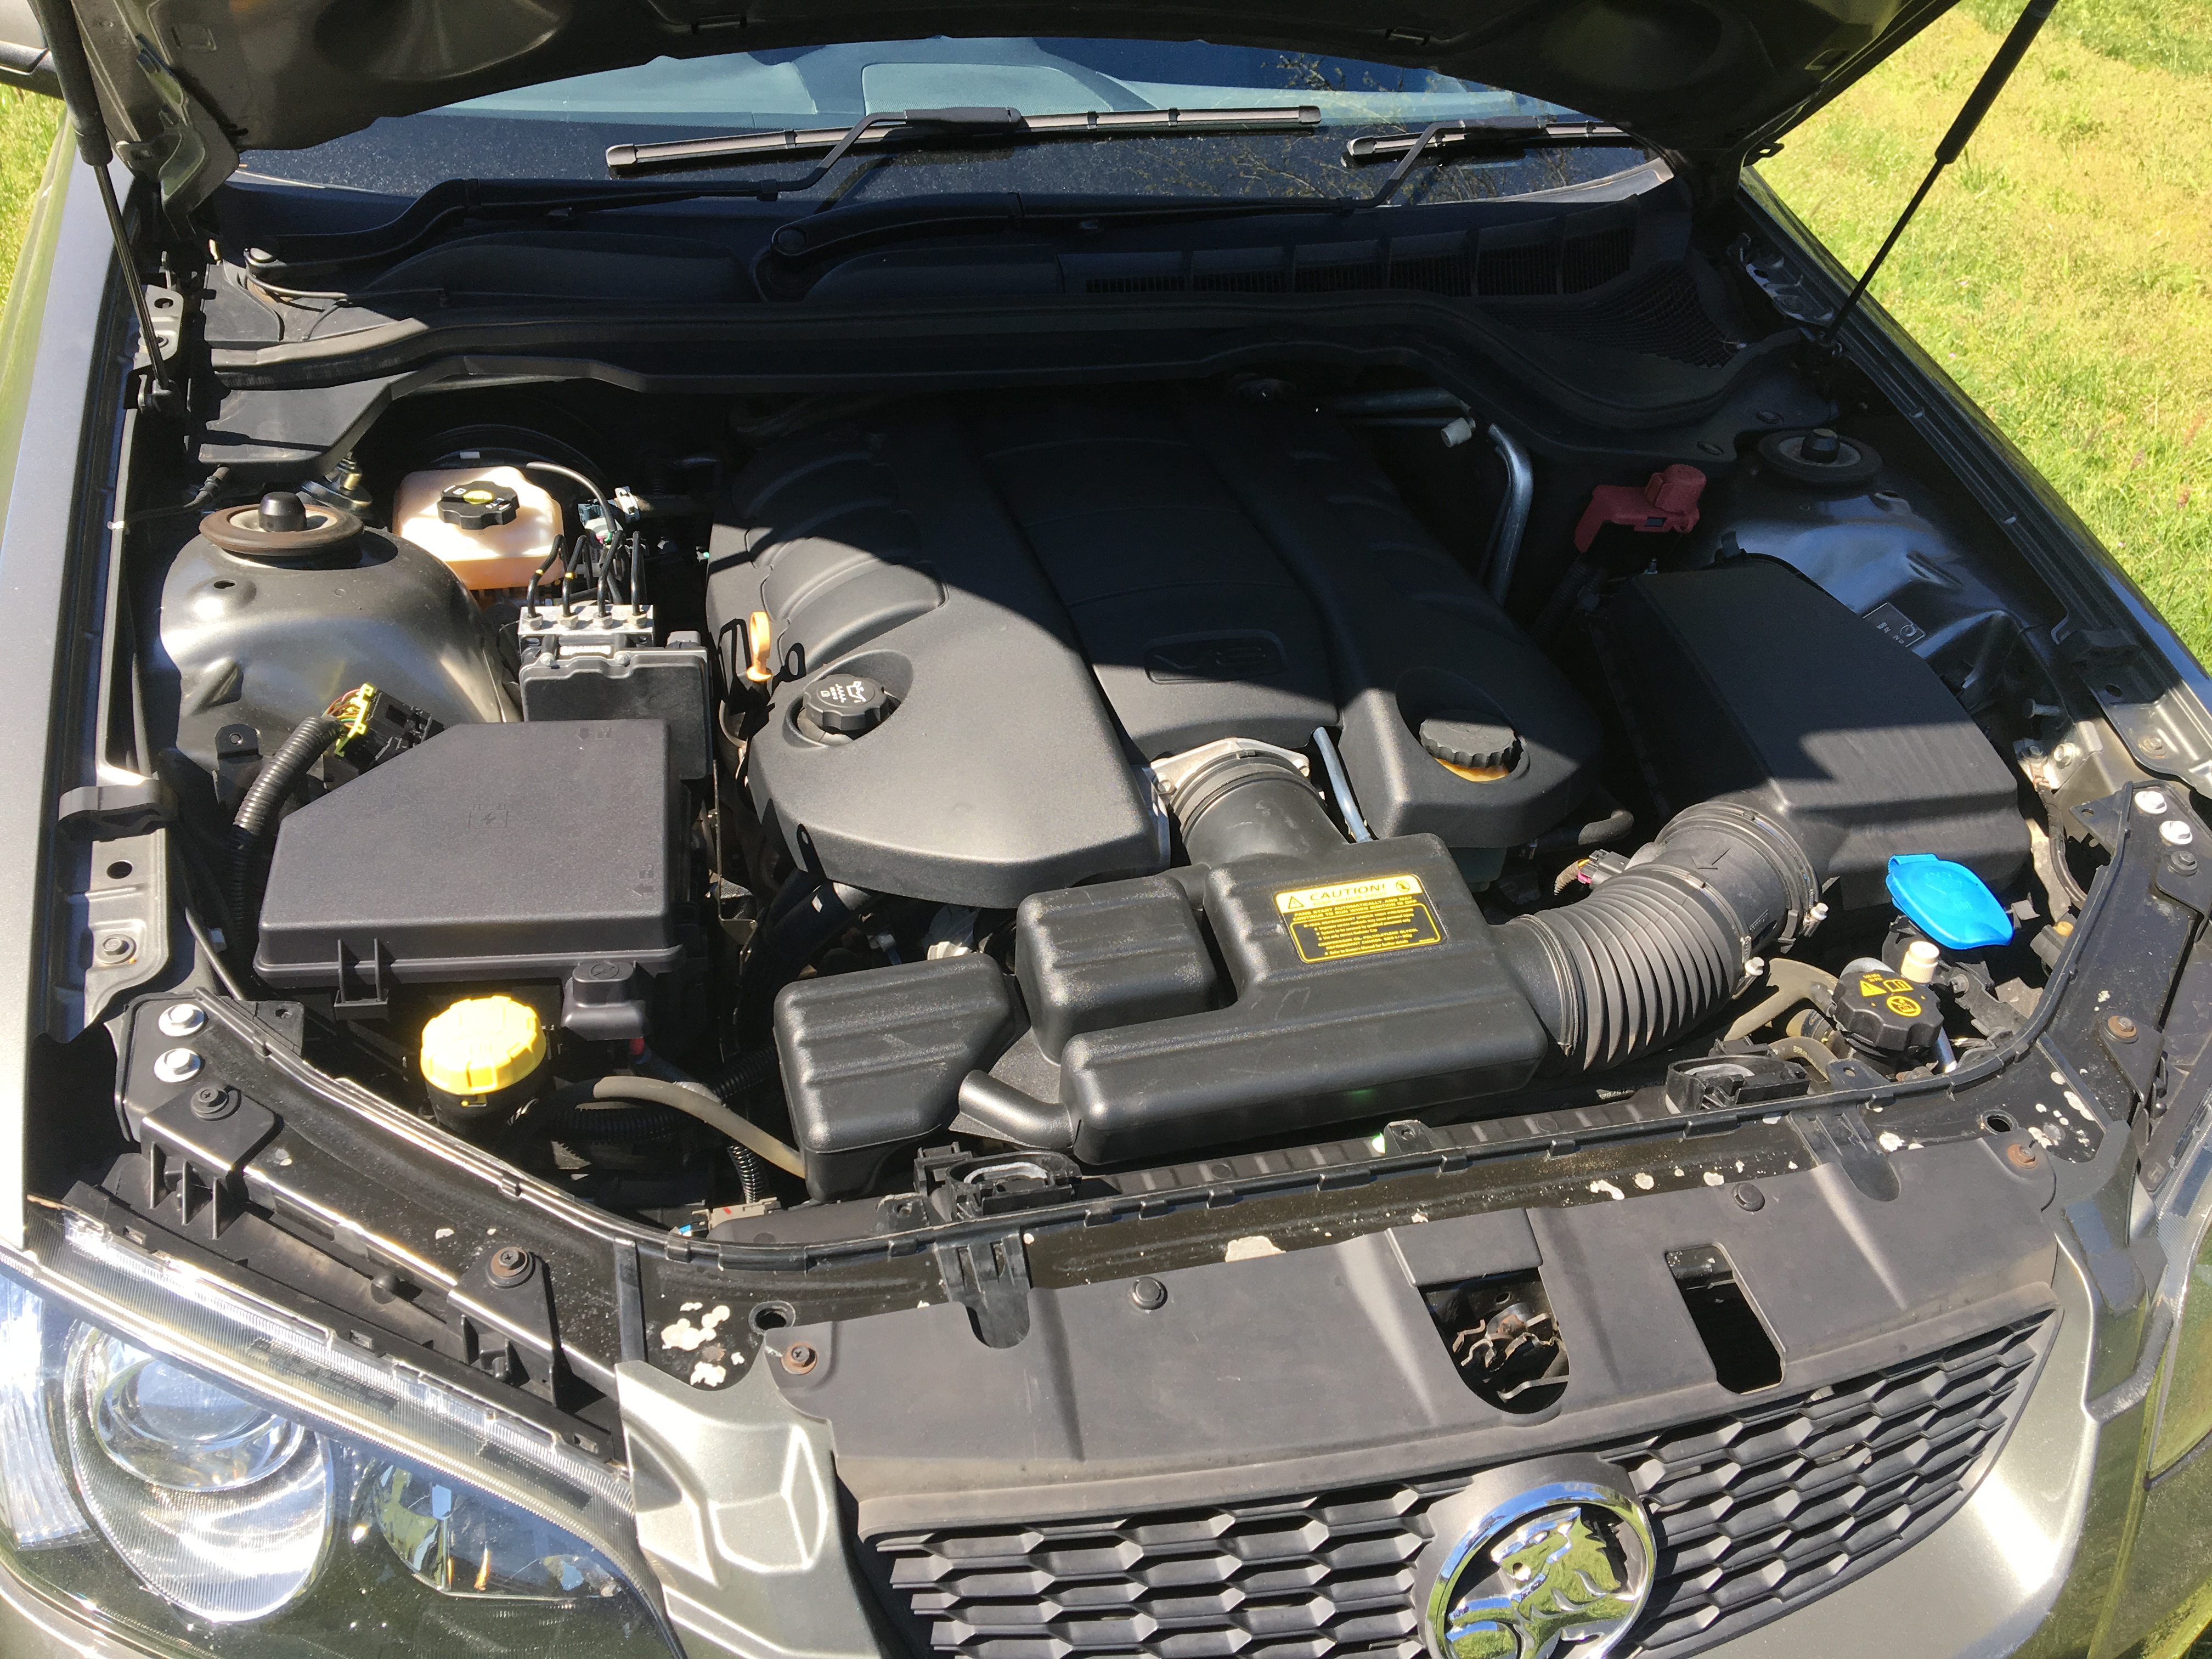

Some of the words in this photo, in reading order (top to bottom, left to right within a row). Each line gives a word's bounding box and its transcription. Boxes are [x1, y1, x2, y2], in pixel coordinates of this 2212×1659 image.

[1310, 884, 1384, 900] CAUTION!
[1318, 938, 1352, 946] COMPRESSOR
[1326, 941, 1360, 950] REFRIGERANT
